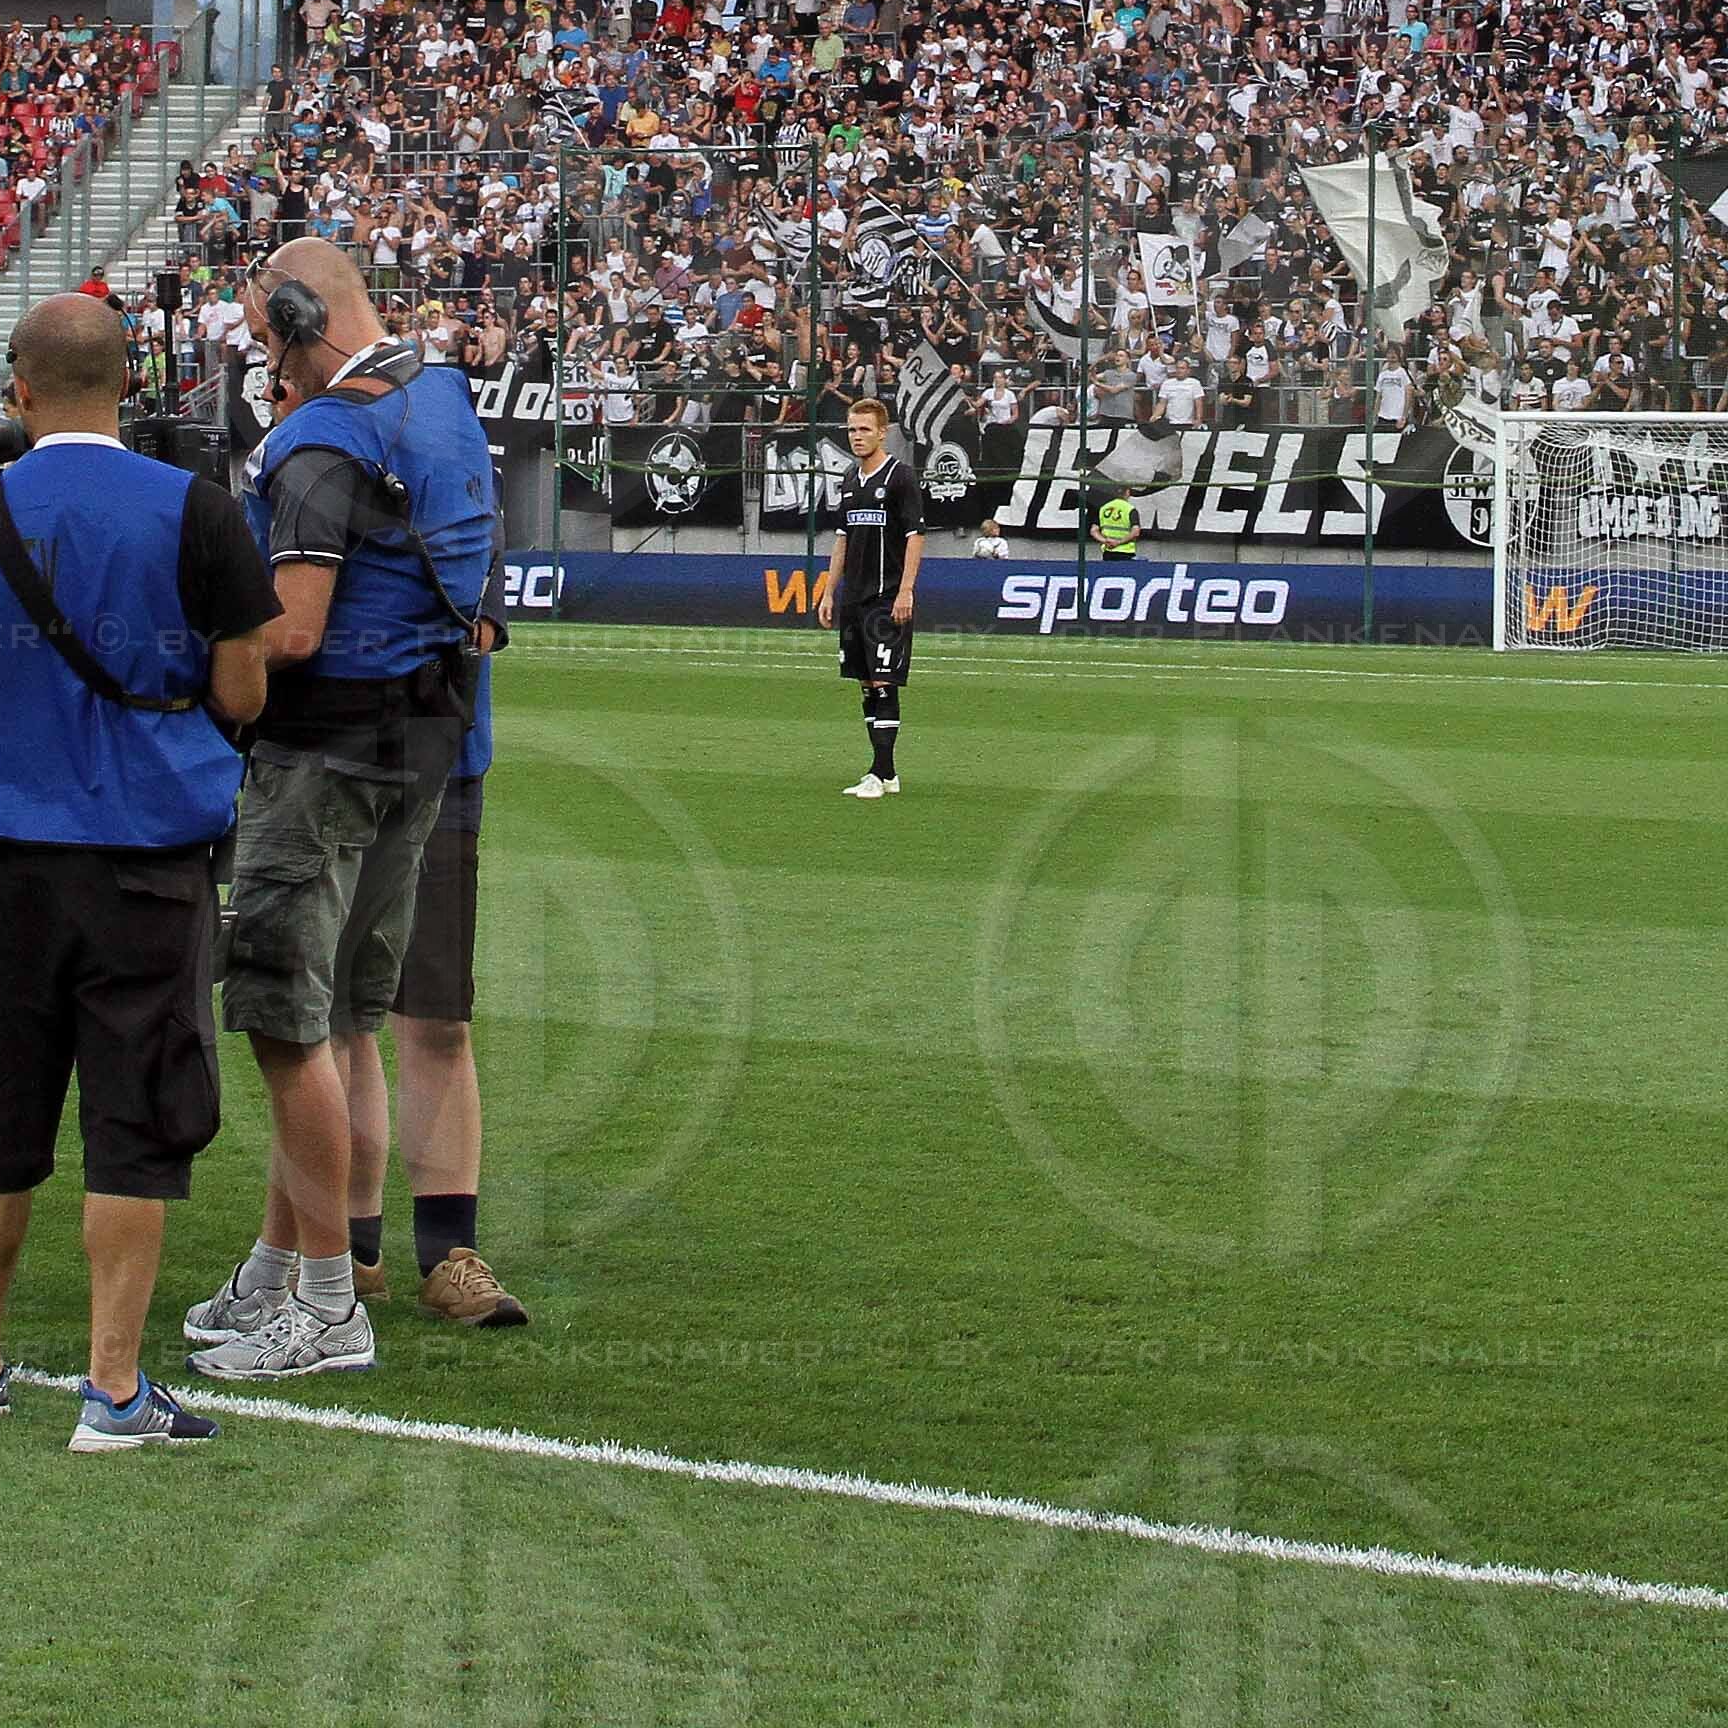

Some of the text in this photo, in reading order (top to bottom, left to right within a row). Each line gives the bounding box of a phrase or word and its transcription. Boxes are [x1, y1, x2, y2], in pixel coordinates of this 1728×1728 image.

[992, 427, 1405, 536] JEWELS
[997, 564, 1290, 635] sporteo
[876, 642, 892, 667] 4
